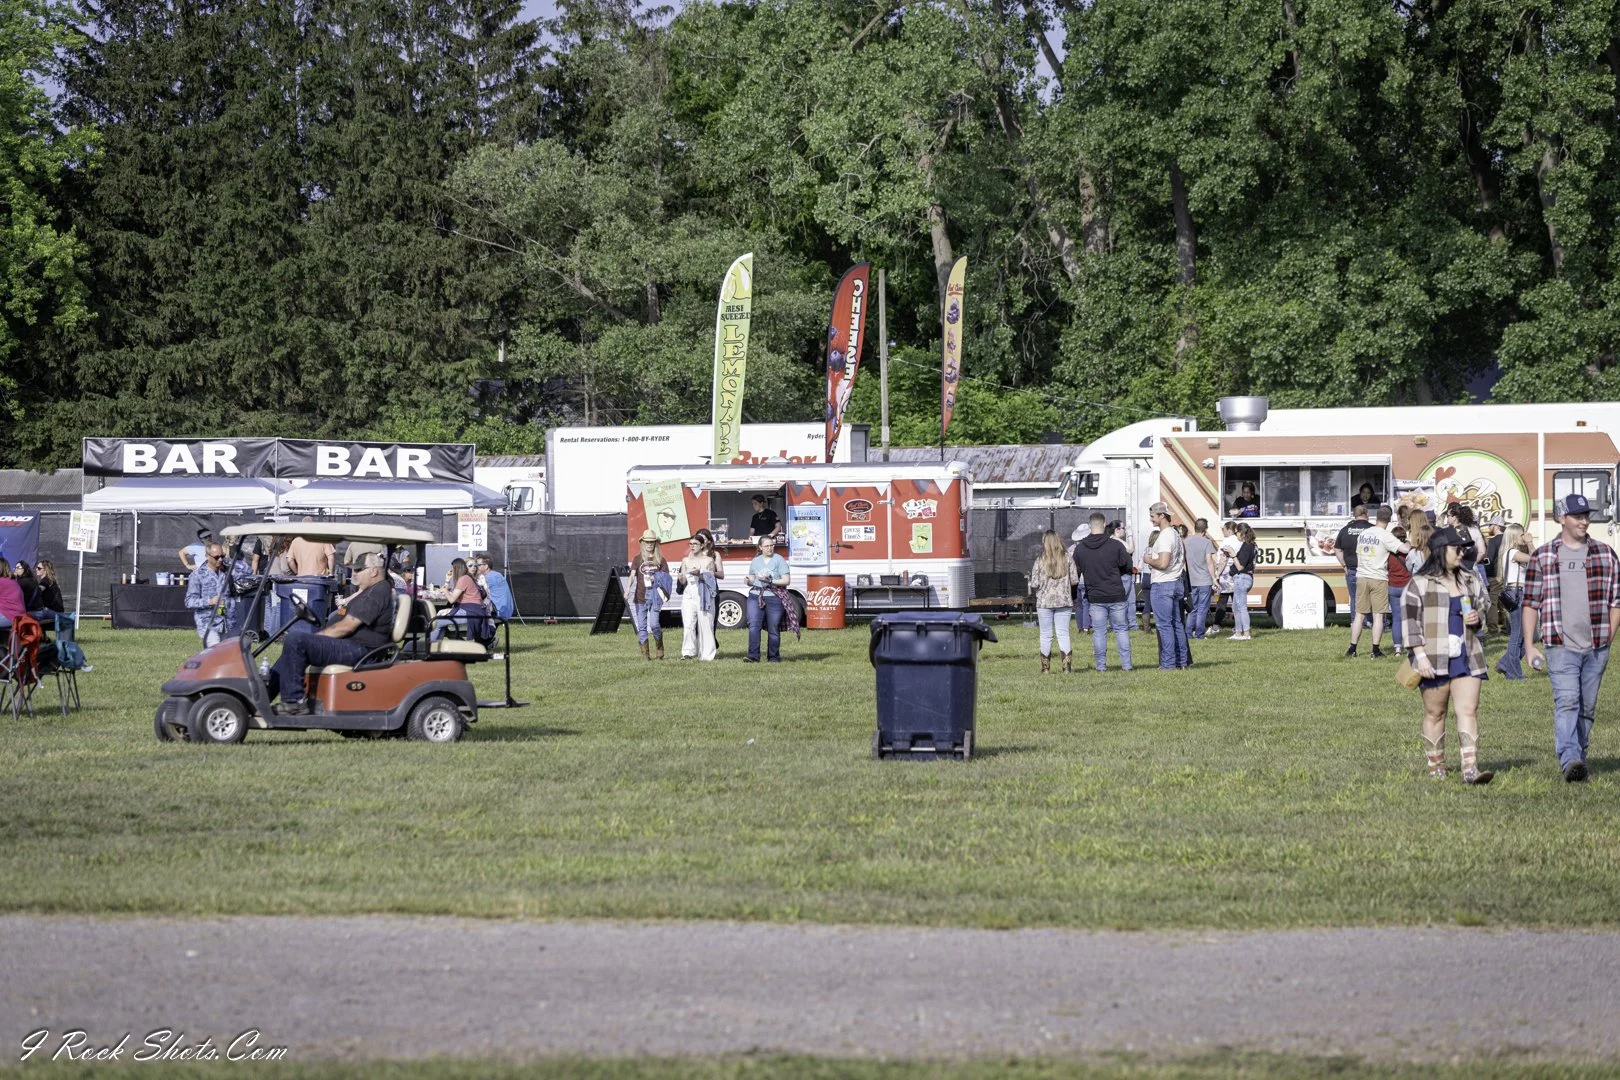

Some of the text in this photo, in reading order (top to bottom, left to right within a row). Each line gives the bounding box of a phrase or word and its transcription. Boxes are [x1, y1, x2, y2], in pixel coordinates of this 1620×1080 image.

[123, 443, 240, 474] BAR
[316, 446, 433, 478] BAR
[731, 450, 817, 465] Ryer
[471, 524, 482, 536] 12
